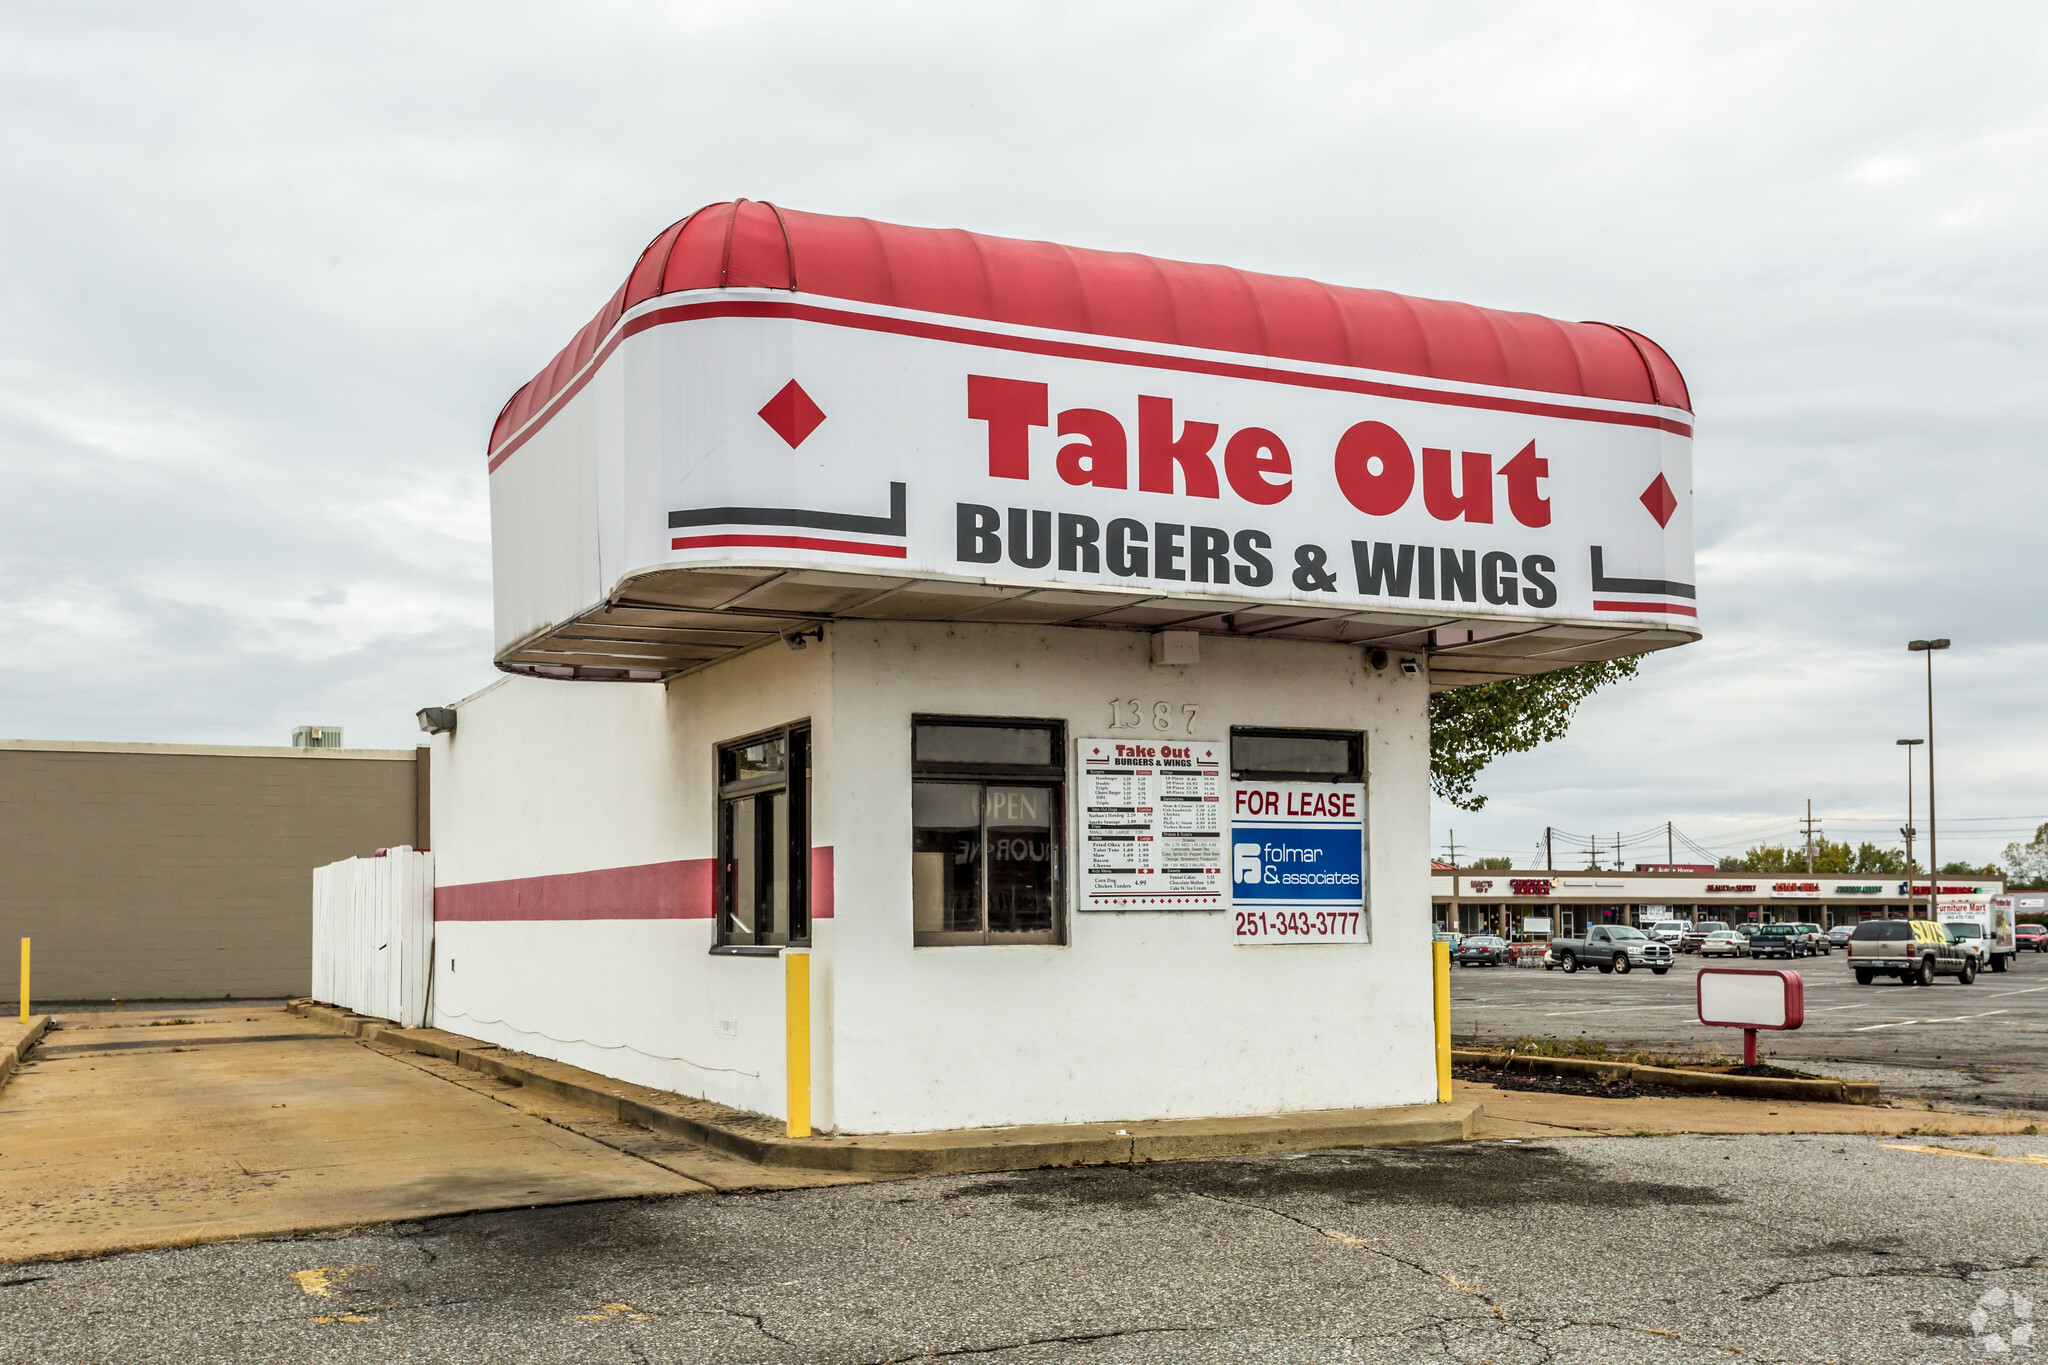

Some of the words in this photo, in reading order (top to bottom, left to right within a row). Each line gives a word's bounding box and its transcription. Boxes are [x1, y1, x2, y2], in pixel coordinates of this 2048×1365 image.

[967, 374, 1293, 505] Take
[1334, 420, 1551, 528] Out
[956, 502, 1274, 588] BURGERS
[1292, 544, 1337, 593] &
[1351, 540, 1558, 609] WINGS
[1109, 698, 1198, 734] 1387
[1116, 744, 1156, 758] Take
[1161, 745, 1190, 758] Out
[1115, 758, 1154, 766] BURGERS
[1163, 759, 1192, 767] WINGS
[1236, 790, 1279, 816] FOR
[1287, 792, 1355, 817] LEASE
[1264, 843, 1322, 863] folmar
[1264, 865, 1280, 884] &
[1282, 870, 1359, 884] associates
[1510, 879, 1550, 887] CHICKEN
[1513, 887, 1550, 895] KORNER
[1776, 882, 1797, 891] ASIAN
[1800, 883, 1821, 892] GRILL
[1936, 903, 1967, 912] Furniture
[1969, 903, 1986, 912] Mart
[1235, 912, 1359, 936] 251-343-3777
